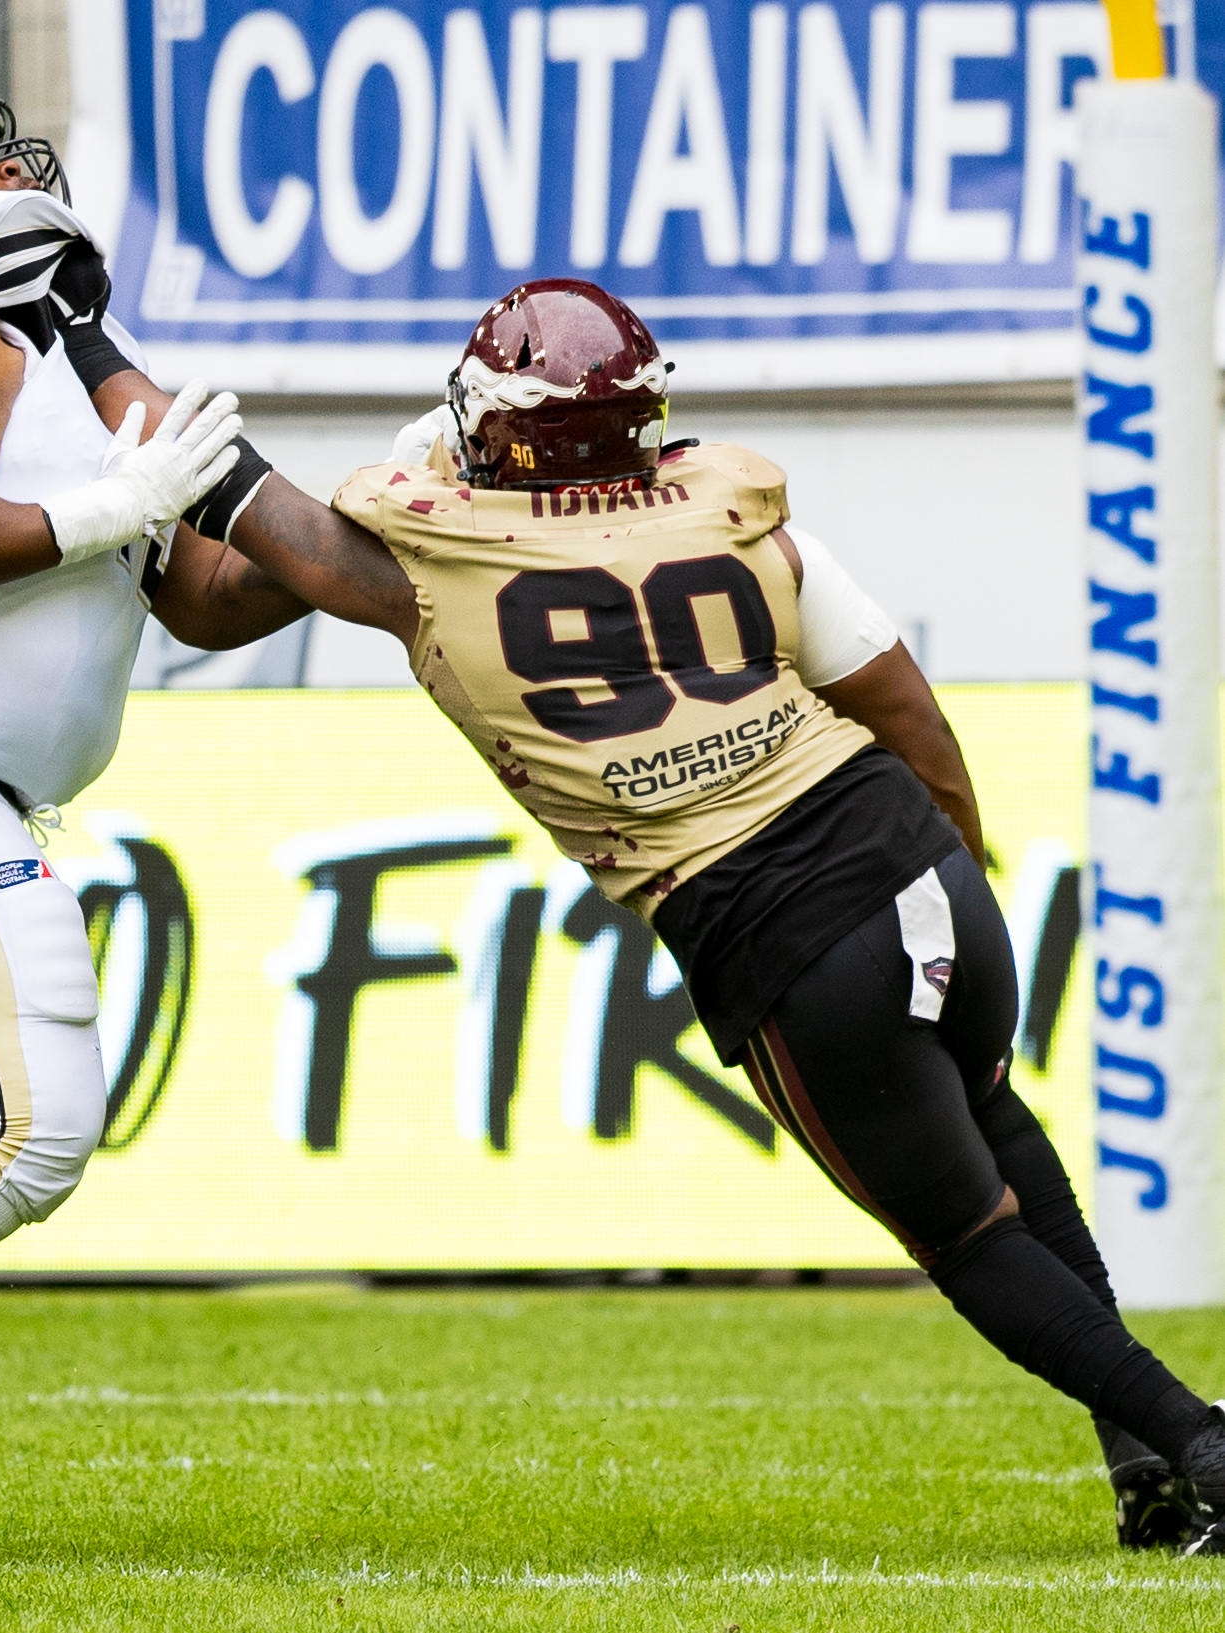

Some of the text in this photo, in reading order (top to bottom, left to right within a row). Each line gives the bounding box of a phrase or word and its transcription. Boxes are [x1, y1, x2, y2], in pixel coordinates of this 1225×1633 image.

[204, 5, 1105, 279] CONTAINER
[511, 443, 535, 469] 90
[496, 553, 779, 743] 90
[1083, 202, 1167, 1209] JUST FINANCE
[601, 697, 798, 780] AMERICAN
[699, 774, 734, 792] SINCE
